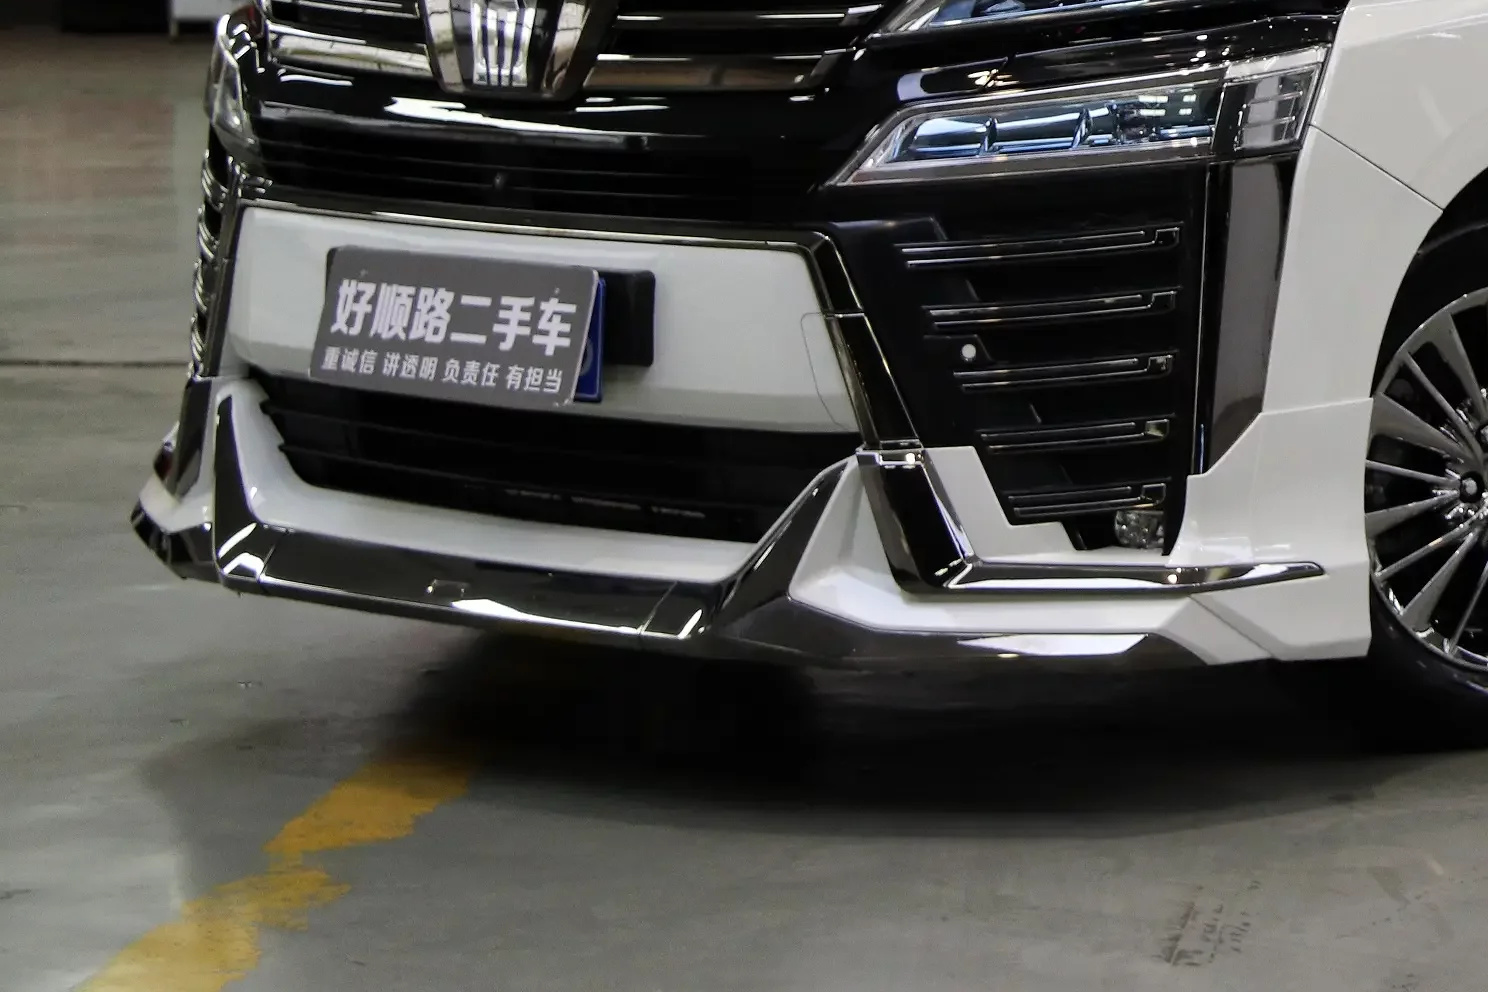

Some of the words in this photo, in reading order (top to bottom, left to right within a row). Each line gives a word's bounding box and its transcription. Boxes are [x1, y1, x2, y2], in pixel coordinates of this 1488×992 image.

[330, 279, 577, 357] 好顺路二手车
[320, 346, 379, 374] 重诚信
[381, 351, 439, 382] 讲透明
[441, 358, 500, 389] 负责任
[505, 364, 563, 394] 有担当
